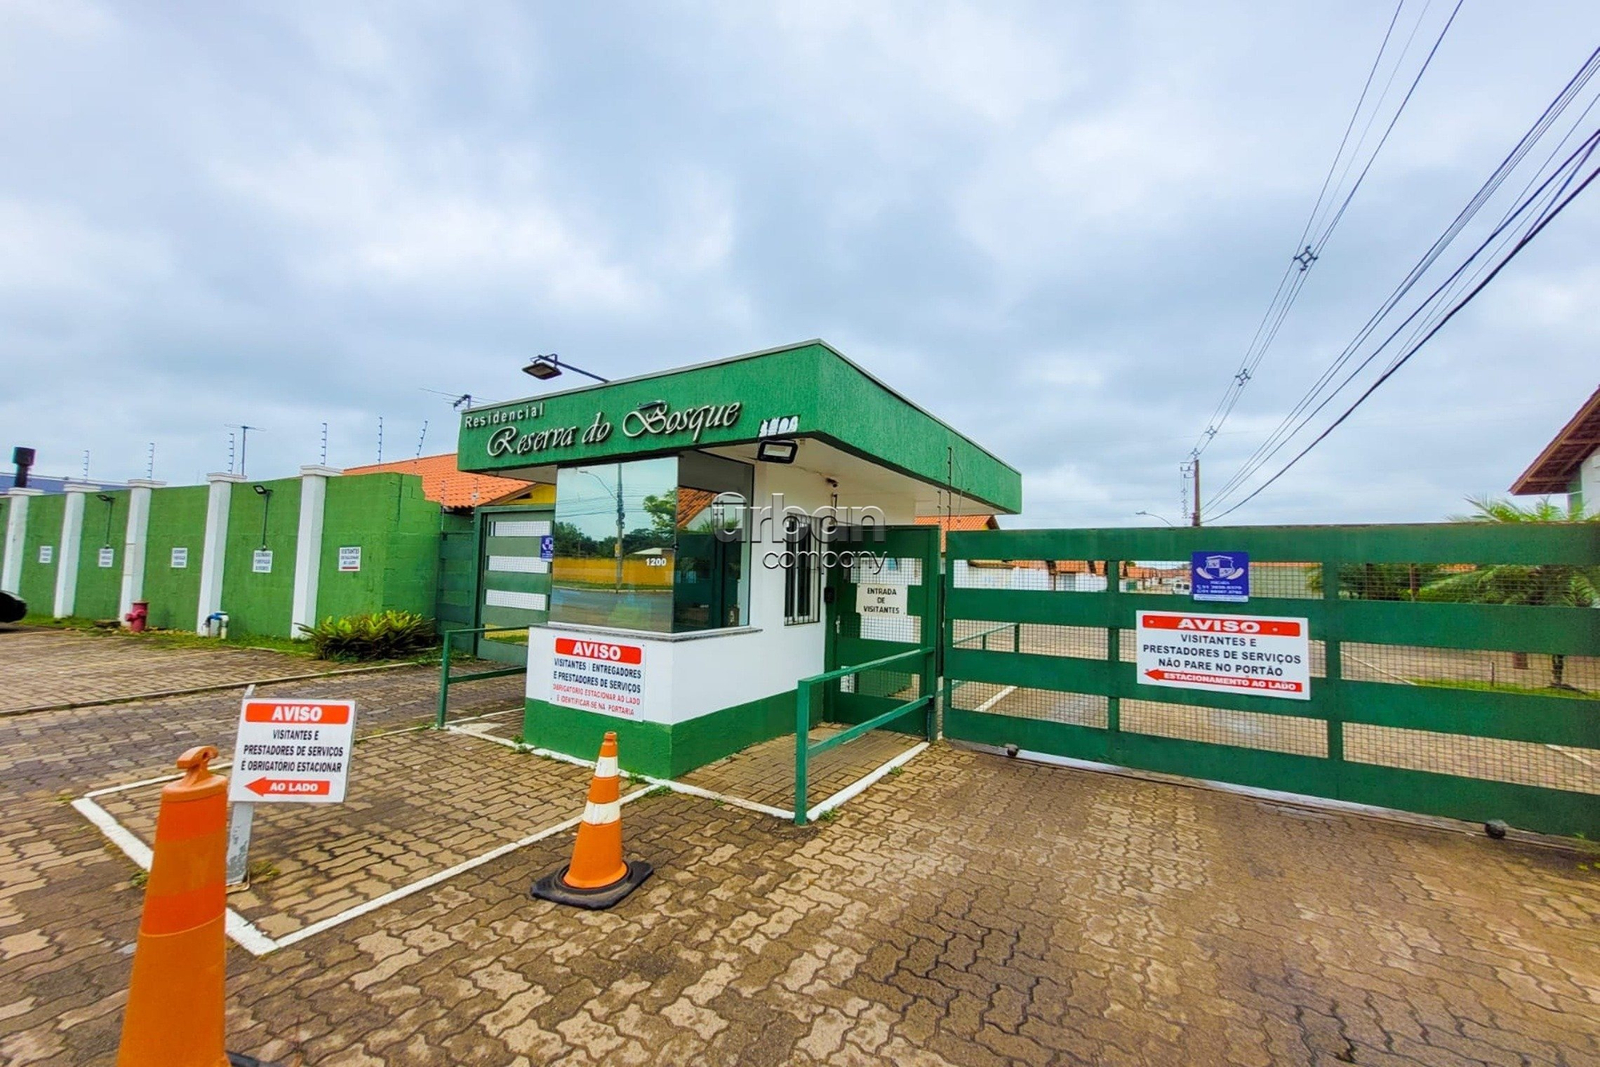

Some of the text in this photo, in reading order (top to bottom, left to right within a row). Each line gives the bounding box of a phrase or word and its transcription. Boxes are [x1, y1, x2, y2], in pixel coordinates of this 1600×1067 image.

[464, 402, 545, 429] Residencial
[487, 400, 742, 457] Reserva do Bosque
[645, 558, 667, 566] 1200
[867, 587, 897, 596] ENTRADA
[863, 605, 899, 614] VISITANTES
[1177, 618, 1260, 633] AVISO
[1181, 634, 1256, 647] VISITANTES E
[573, 642, 621, 660] AVISO
[1143, 644, 1301, 665] PRESTADORES DE SERVIÇOS
[554, 657, 642, 679] VISITANTES ENTREGADORES
[1158, 658, 1283, 677] NÃO PARE NO PORTÃO
[553, 670, 641, 694] E PRESTADORES DE SERVIÇOS
[1164, 672, 1297, 690] ESTACIONAMENTO AO LADO
[584, 689, 617, 702] ESTACIONAR
[617, 694, 625, 703] AO
[625, 695, 641, 706] LADO
[271, 706, 322, 721] AVISO
[599, 702, 605, 710] NA
[608, 705, 634, 715] PORTARIA
[273, 729, 319, 740] VISITANTES E
[243, 744, 295, 756] PRESTADORES
[296, 746, 306, 756] DE
[296, 762, 343, 773] ESTACIONAR
[269, 782, 319, 792] AO LADO
